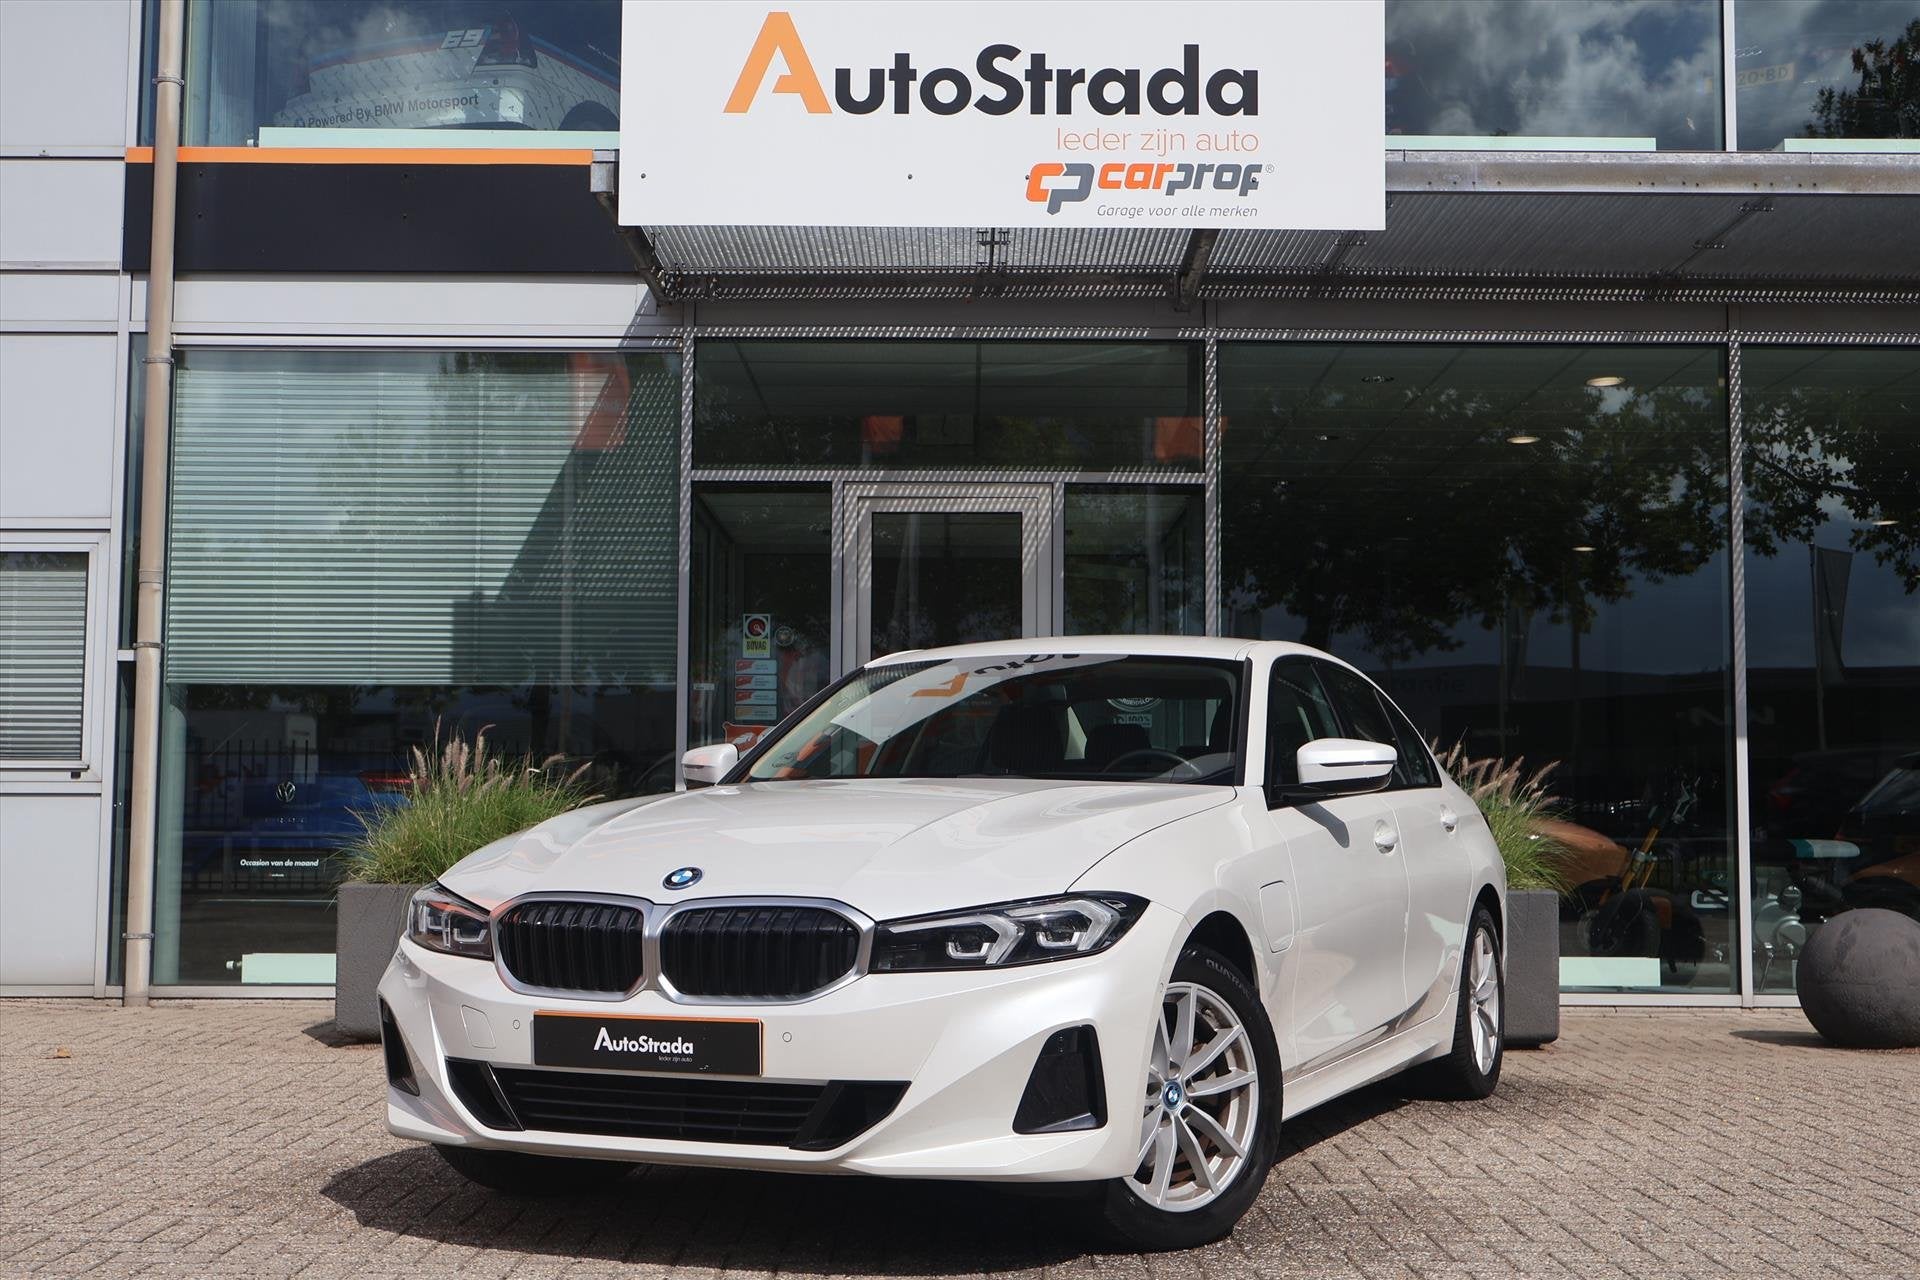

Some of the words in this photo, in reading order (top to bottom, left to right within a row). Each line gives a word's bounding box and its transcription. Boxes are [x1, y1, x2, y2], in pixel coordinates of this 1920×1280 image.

[441, 28, 485, 49] 69
[723, 11, 1259, 116] AutoStrada
[308, 108, 353, 128] Powered
[356, 107, 372, 122] By
[374, 101, 405, 117] BMW
[408, 93, 479, 112] Motorsport
[1057, 128, 1132, 151] Ieder
[1140, 129, 1185, 157] zijn
[1195, 131, 1259, 152] auto
[1097, 204, 1145, 219] Garage
[1149, 207, 1178, 217] voor
[1182, 204, 1206, 217] alle
[1209, 205, 1258, 217] merken
[746, 640, 767, 651] BOVAG
[240, 859, 270, 867] Occasion
[284, 859, 295, 867] de
[294, 859, 320, 867] maand
[593, 1026, 694, 1055] AutoStrada
